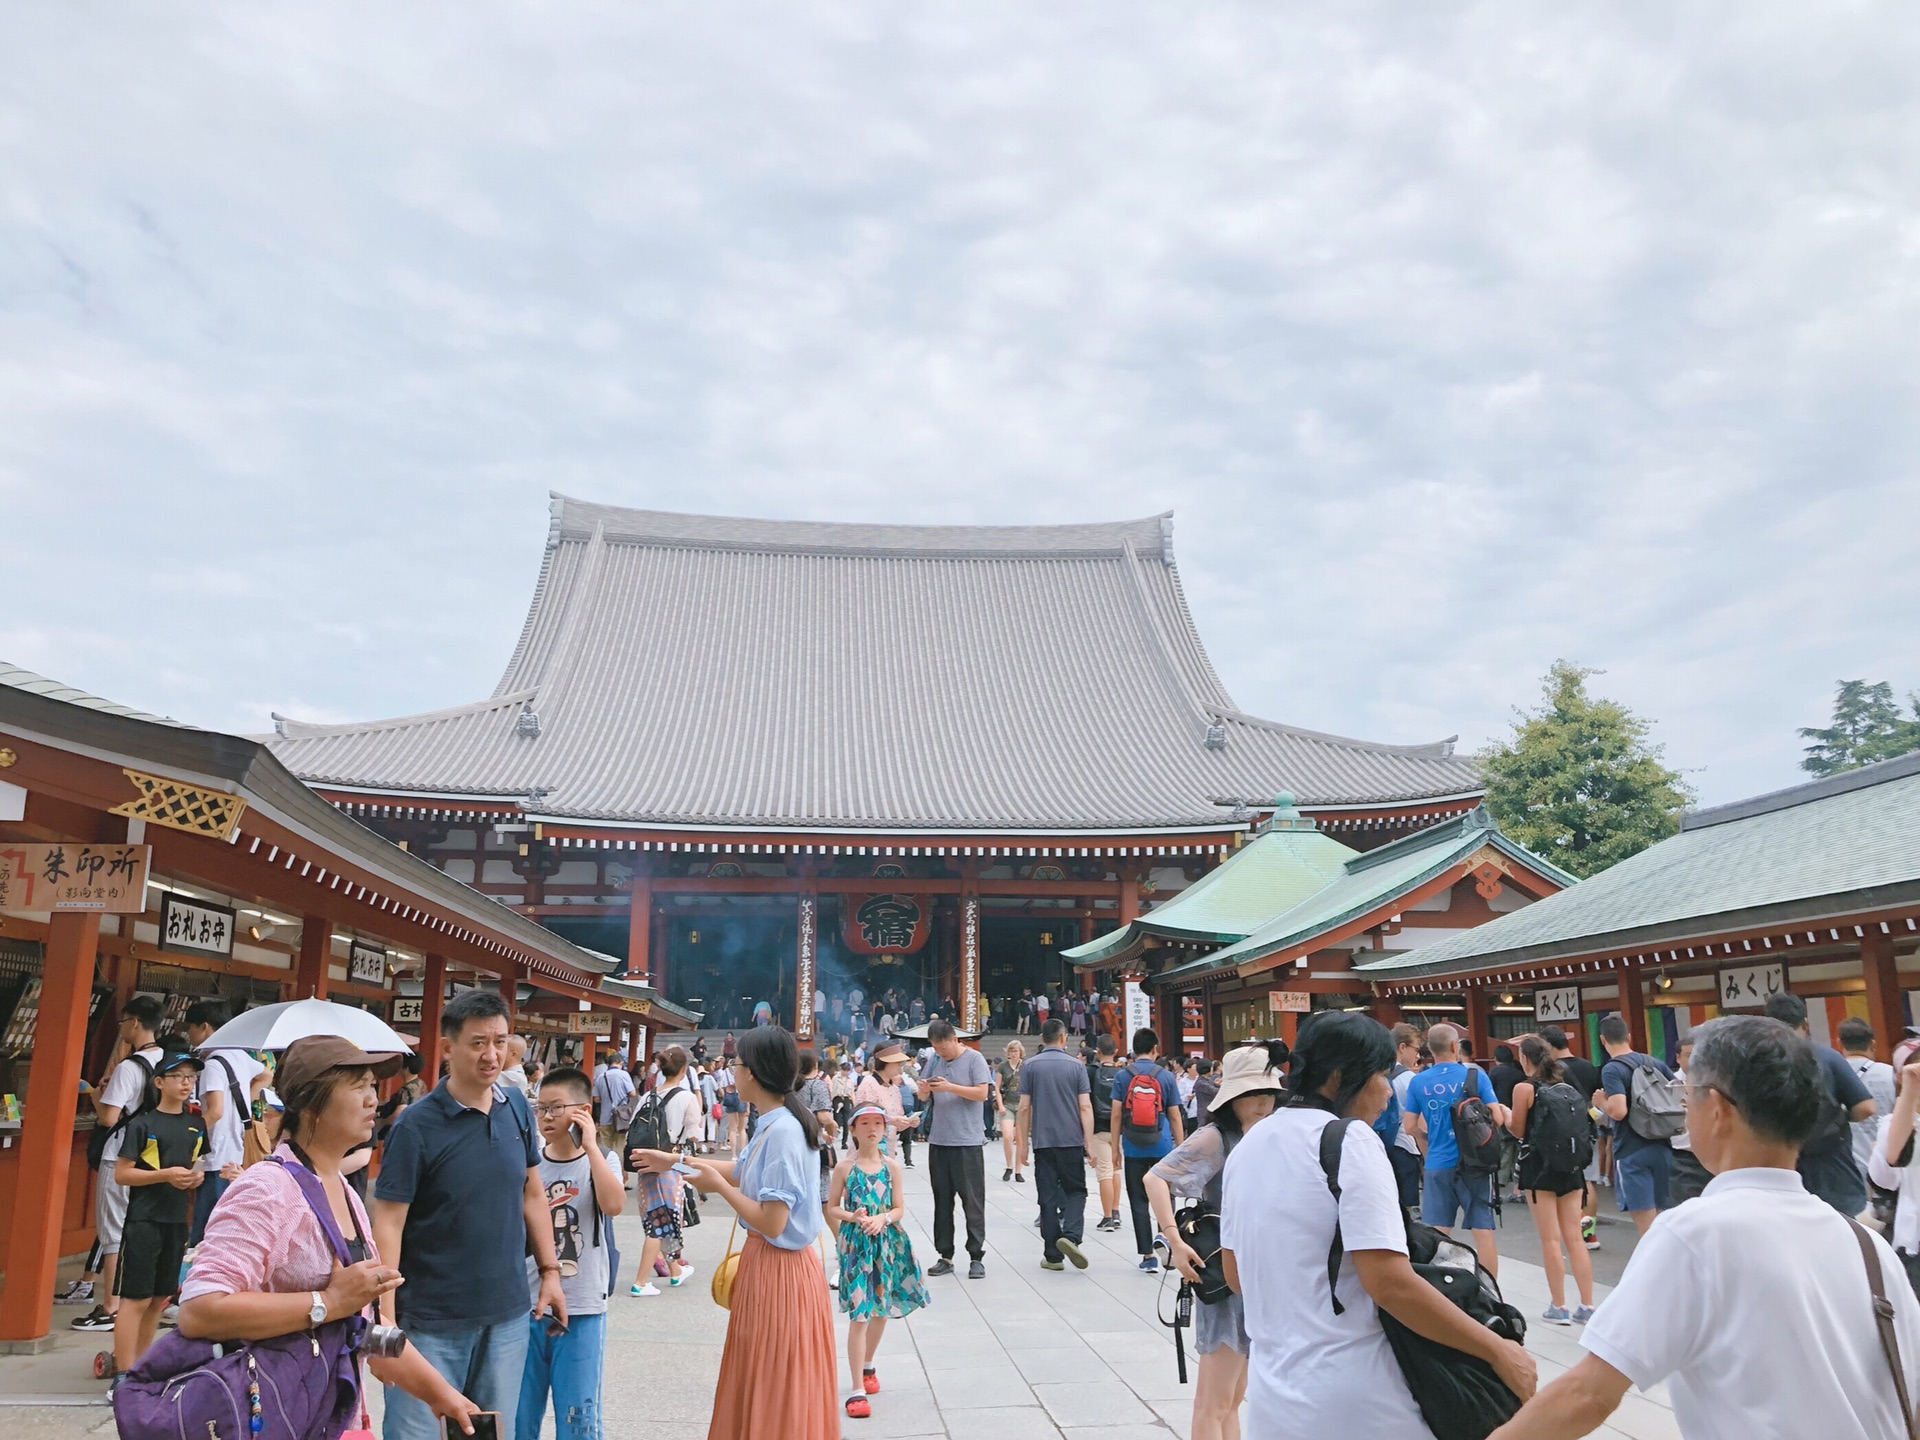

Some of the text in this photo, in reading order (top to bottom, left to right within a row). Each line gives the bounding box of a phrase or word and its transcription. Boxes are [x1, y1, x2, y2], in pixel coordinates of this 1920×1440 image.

[43, 846, 139, 886] 朱印所
[168, 907, 225, 948] お札お守
[1725, 968, 1780, 1000] みくじ
[1541, 991, 1576, 1016] みくじ
